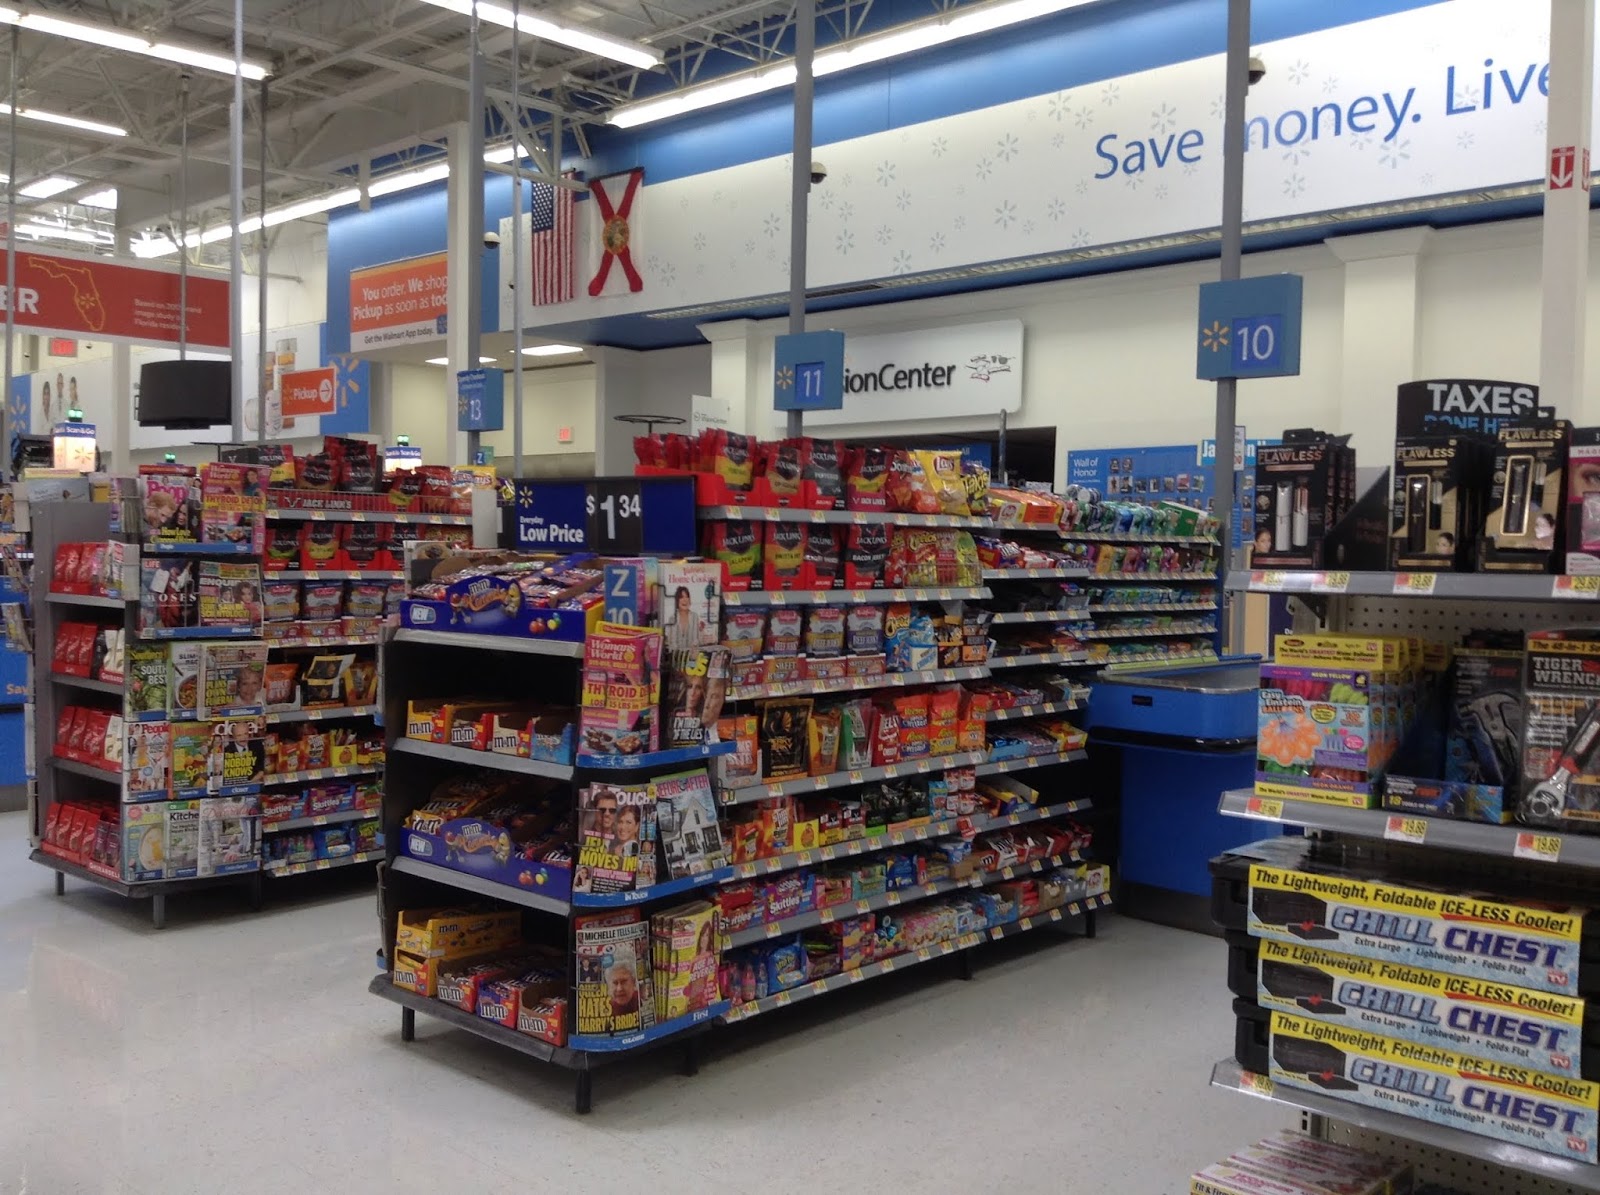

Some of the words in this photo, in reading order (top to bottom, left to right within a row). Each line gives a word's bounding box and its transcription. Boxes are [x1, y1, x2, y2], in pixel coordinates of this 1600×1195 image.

[1094, 128, 1204, 179] Save
[363, 288, 379, 300] You
[381, 284, 406, 298] order.
[408, 278, 423, 293] We
[353, 304, 382, 320] Pickup
[384, 305, 394, 315] as
[395, 300, 417, 313] soon
[420, 297, 429, 309] as
[431, 294, 447, 307] tod
[364, 336, 373, 344] Get
[374, 334, 382, 342] the
[383, 331, 404, 341] Walmart
[405, 329, 416, 338] App
[1237, 324, 1276, 361] 10
[803, 370, 820, 398] 11
[843, 362, 956, 394] ionCenter
[293, 388, 318, 402] Pickup
[1427, 383, 1534, 415] TAXES
[470, 400, 481, 420] 13
[1499, 430, 1564, 441] FLAWLESS
[1073, 458, 1089, 467] Wall
[1089, 457, 1098, 467] of
[1258, 450, 1322, 463] FLAWLESS
[1397, 448, 1456, 460] FLAWLESS
[1073, 468, 1097, 477] Honor
[303, 500, 324, 508] JACK
[586, 494, 595, 516] $
[619, 494, 642, 519] 34
[520, 516, 543, 526] Everyday
[520, 525, 547, 541] Low
[550, 524, 584, 543] Price
[611, 569, 629, 597] Z
[608, 608, 634, 625] 10
[591, 640, 636, 653] Woman's
[1533, 641, 1549, 650] The
[589, 650, 623, 661] World
[1532, 656, 1583, 671] TIGER
[1533, 670, 1600, 686] WRENC
[6, 684, 28, 695] Sav
[1262, 691, 1281, 700] Easy
[691, 728, 703, 740] LIES
[225, 757, 257, 767] NOBODY
[224, 767, 253, 778] KNOWS
[687, 775, 709, 793] AFTER
[264, 805, 292, 816] Skittles
[313, 799, 340, 811] Skittles
[170, 812, 199, 821] Kitche
[579, 851, 619, 870] MOVES
[622, 856, 637, 871] IN!
[770, 896, 800, 914] Skittles
[1256, 869, 1279, 885] The
[1283, 875, 1368, 902] Lightweight,
[1374, 888, 1436, 910] Foldable
[1441, 899, 1509, 921] ICE-LESS
[1514, 911, 1573, 932] Cooler!
[585, 929, 616, 940] MICHELLE
[617, 928, 630, 937] TELLS
[1332, 906, 1437, 946] CHILL
[1444, 927, 1565, 966] CHEST
[1355, 937, 1375, 948] Extra
[1377, 942, 1400, 953] Large
[1416, 947, 1467, 965] Lightweight
[1482, 959, 1506, 971] Folds
[1509, 964, 1527, 975] Flat
[1266, 943, 1288, 958] The
[1291, 948, 1375, 978] Lightweight,
[1379, 964, 1441, 989] Foldable
[1445, 978, 1513, 1000] ICE-LESS
[1518, 991, 1575, 1016] Cooler!
[579, 984, 607, 998] QUEEN
[579, 997, 612, 1016] HATES
[693, 1009, 708, 1020] First
[579, 1016, 614, 1032] HARRY'S
[615, 1012, 639, 1030] BRIDE!
[1339, 981, 1441, 1024] CHILL
[1449, 1005, 1568, 1051] CHEST
[622, 1034, 644, 1044] GLOBE
[1361, 1012, 1381, 1024] Extra
[1384, 1017, 1406, 1030] Large
[1421, 1024, 1470, 1044] Lightweight
[1486, 1038, 1509, 1050] Folds
[1512, 1044, 1529, 1056] Flat
[1277, 1015, 1299, 1032] The
[1304, 1021, 1388, 1055] Lightweight,
[1391, 1043, 1454, 1068] Foldable
[1458, 1058, 1527, 1081] ICE-LESS
[1532, 1073, 1591, 1099] Cooler!
[1351, 1057, 1455, 1103] CHILL
[1462, 1084, 1585, 1134] CHEST
[1374, 1089, 1394, 1100] Extra
[1396, 1093, 1420, 1109] Large
[1435, 1103, 1485, 1124] Lightweight
[1501, 1119, 1523, 1132] Folds
[1527, 1127, 1545, 1139] Flat
[1195, 1182, 1204, 1192] Fit
